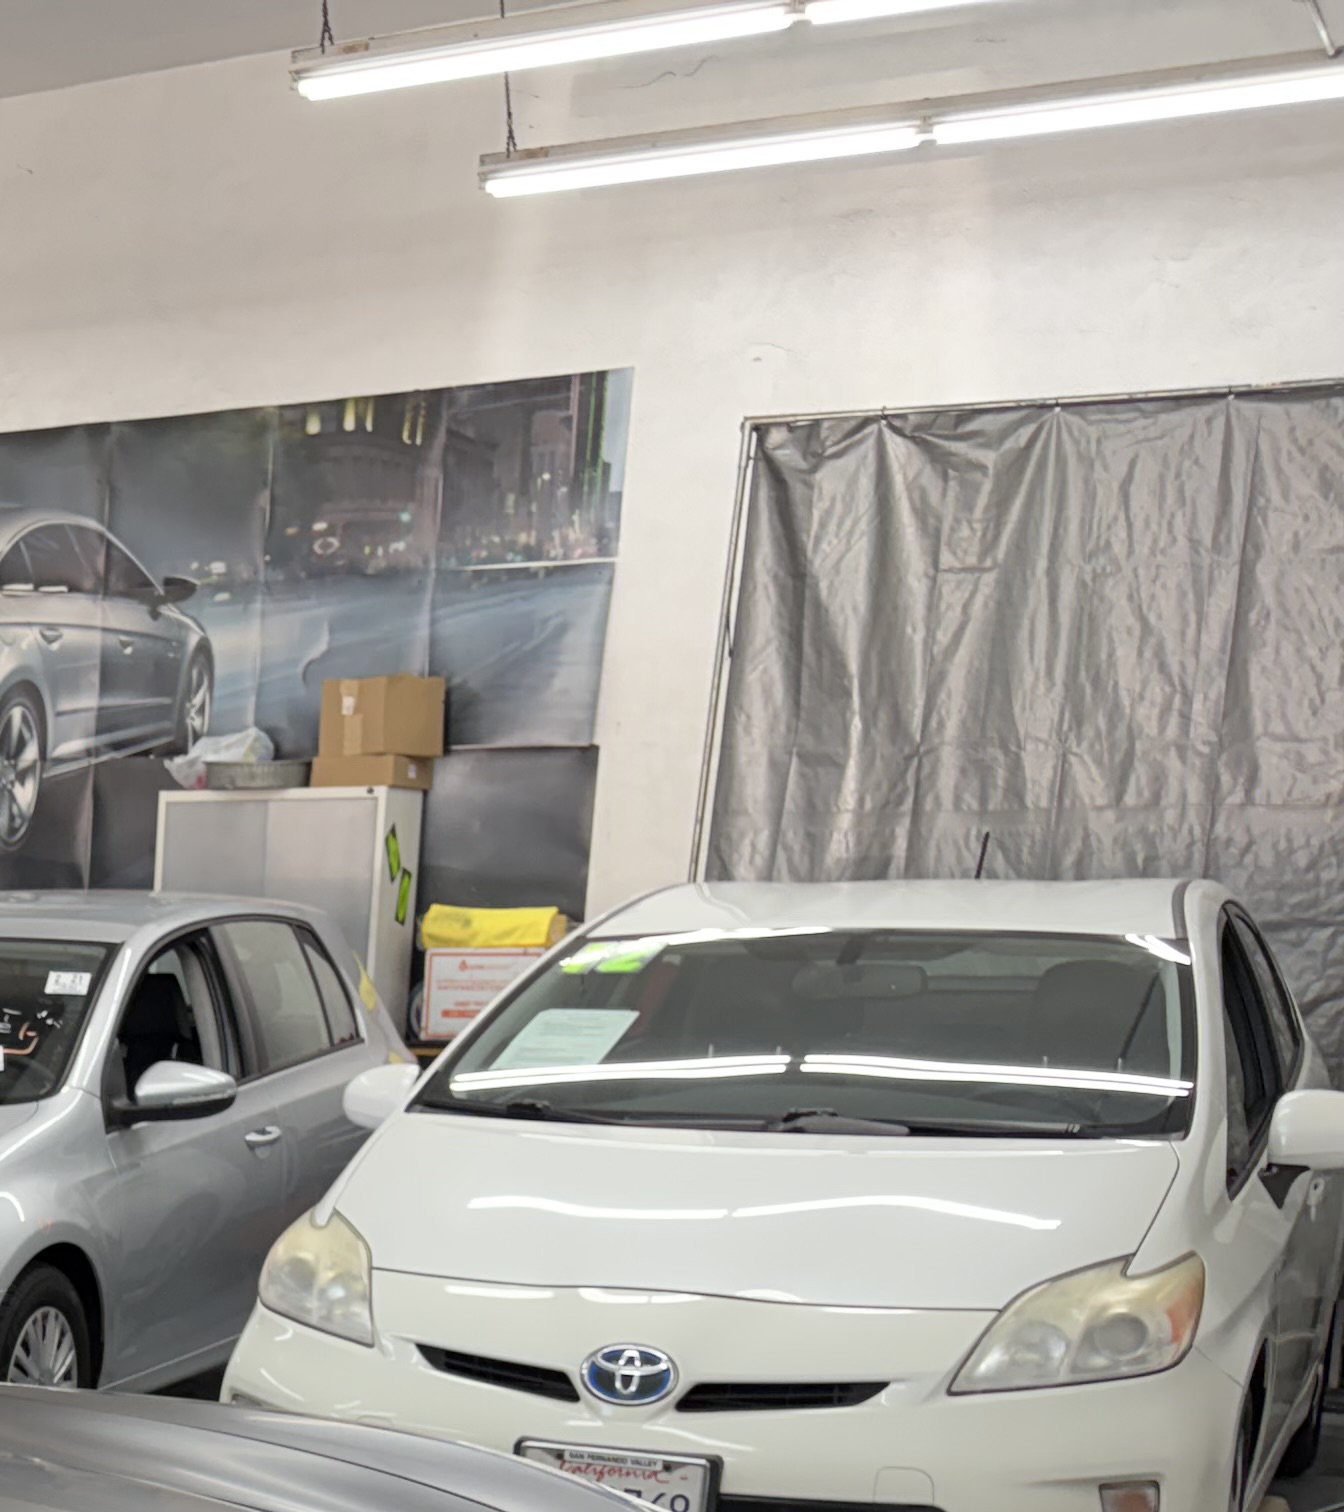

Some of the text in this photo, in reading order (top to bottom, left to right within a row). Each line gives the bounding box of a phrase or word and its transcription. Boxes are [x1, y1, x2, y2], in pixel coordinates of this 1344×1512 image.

[569, 1452, 658, 1468] SAN FERNANDO VALLEY
